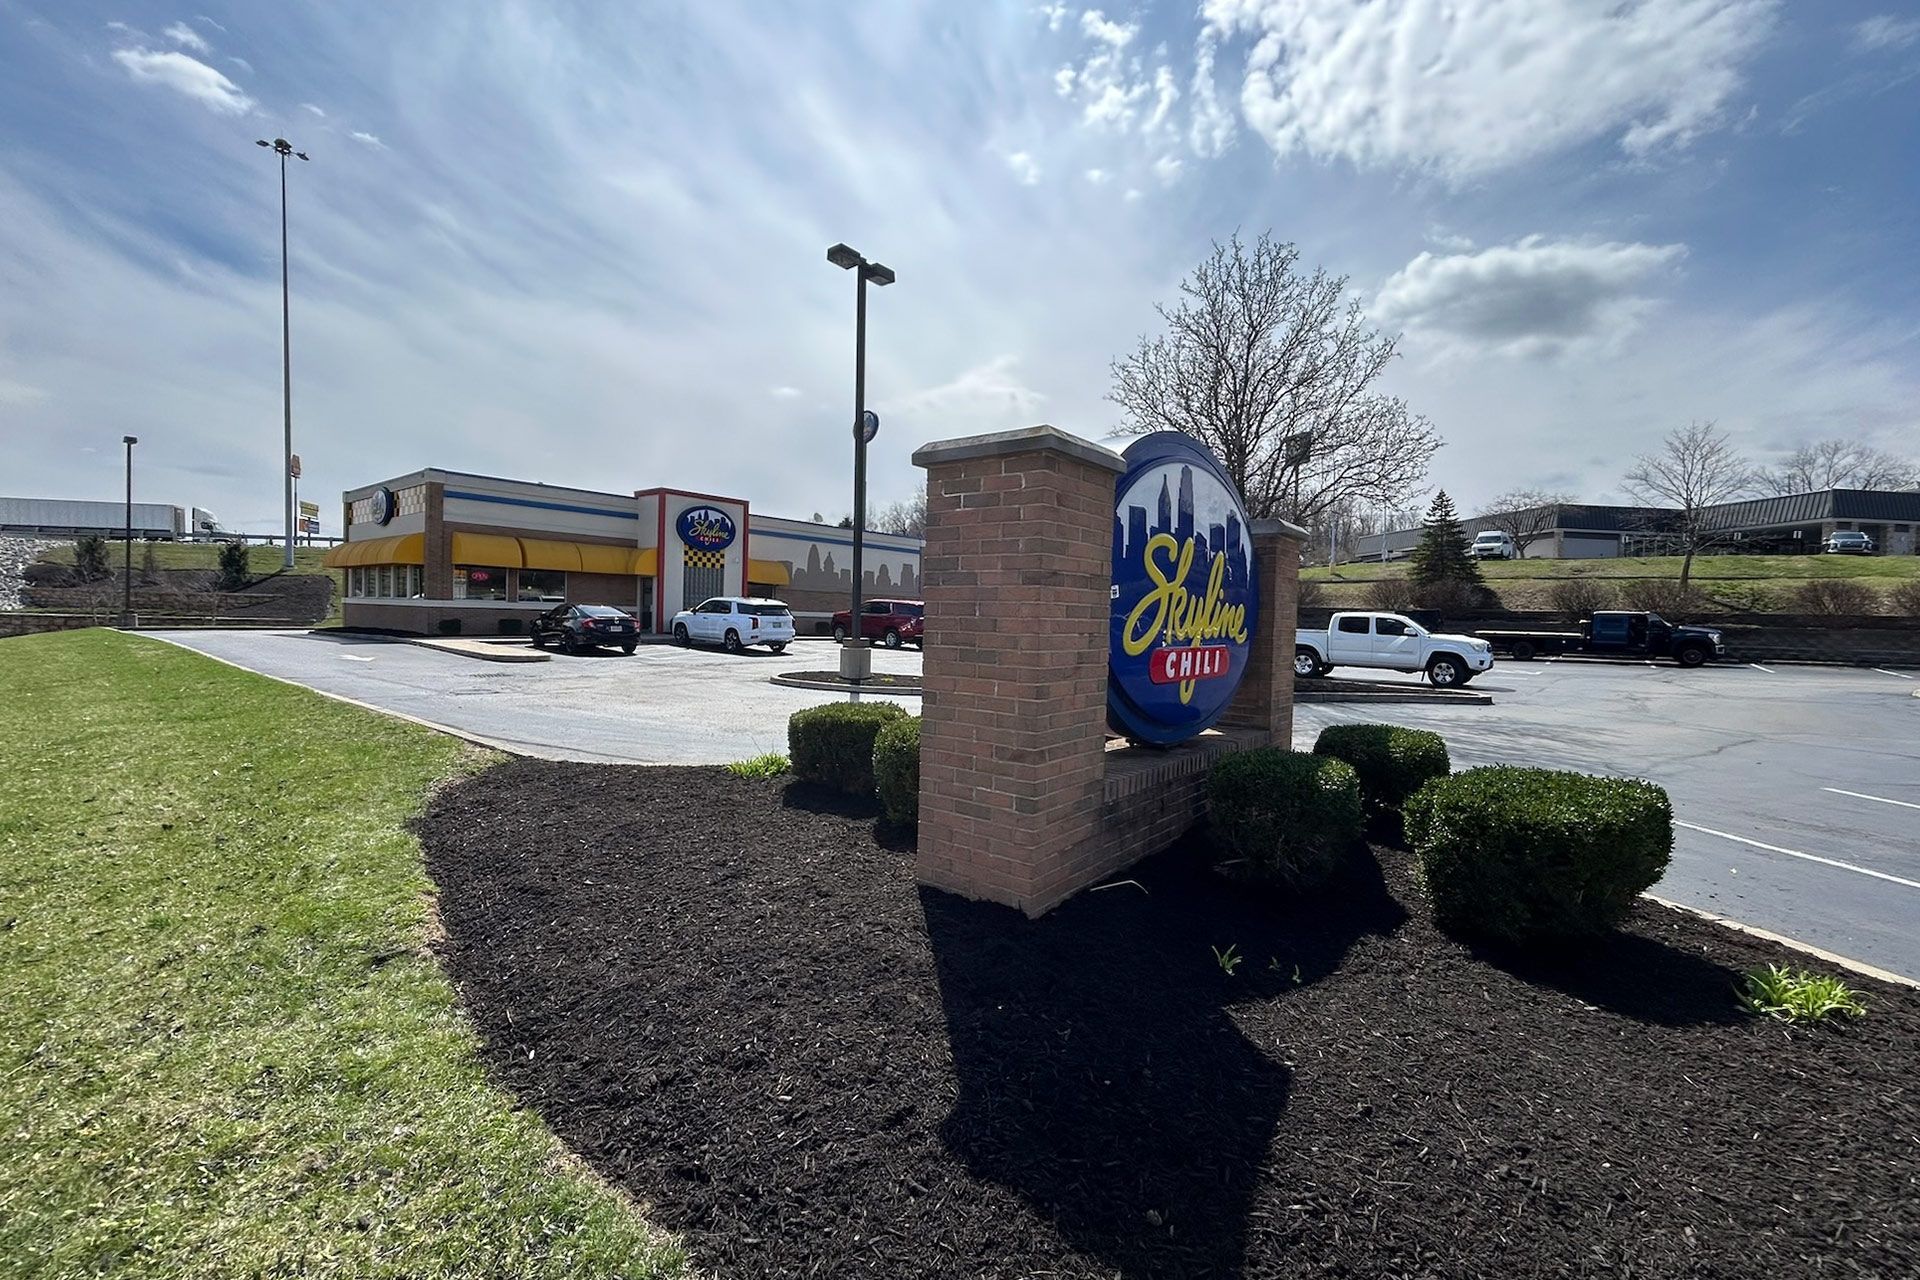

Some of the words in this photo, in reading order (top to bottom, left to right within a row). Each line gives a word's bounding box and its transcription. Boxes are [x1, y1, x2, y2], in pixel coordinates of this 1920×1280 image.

[688, 520, 730, 545] Skyline
[1122, 533, 1248, 705] Skyline
[1165, 650, 1220, 679] CHILI
